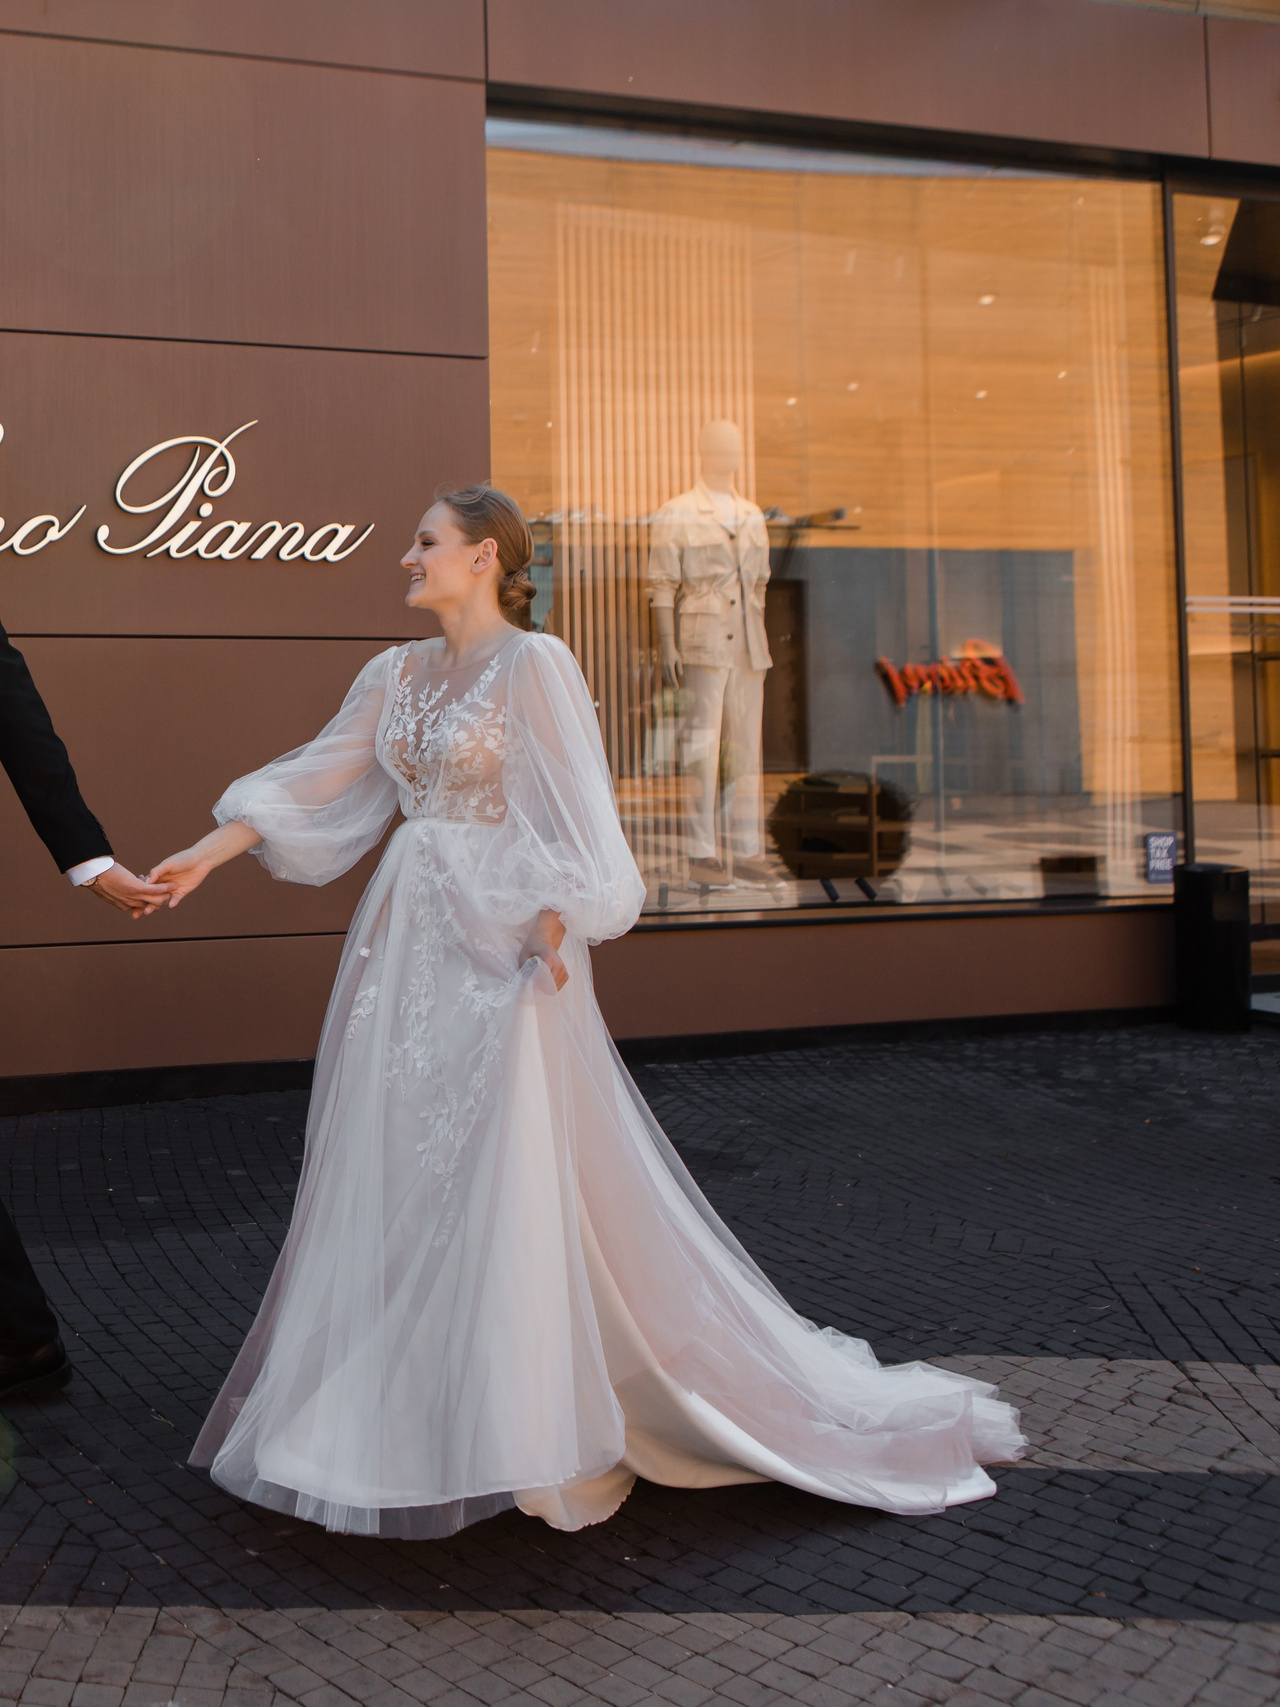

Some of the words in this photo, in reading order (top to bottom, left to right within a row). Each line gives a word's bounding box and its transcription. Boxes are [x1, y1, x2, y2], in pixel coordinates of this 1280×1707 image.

[96, 419, 375, 563] Piana
[1149, 836, 1174, 848] SHOP
[1150, 848, 1169, 858] TAX
[1150, 858, 1173, 870] FREE
